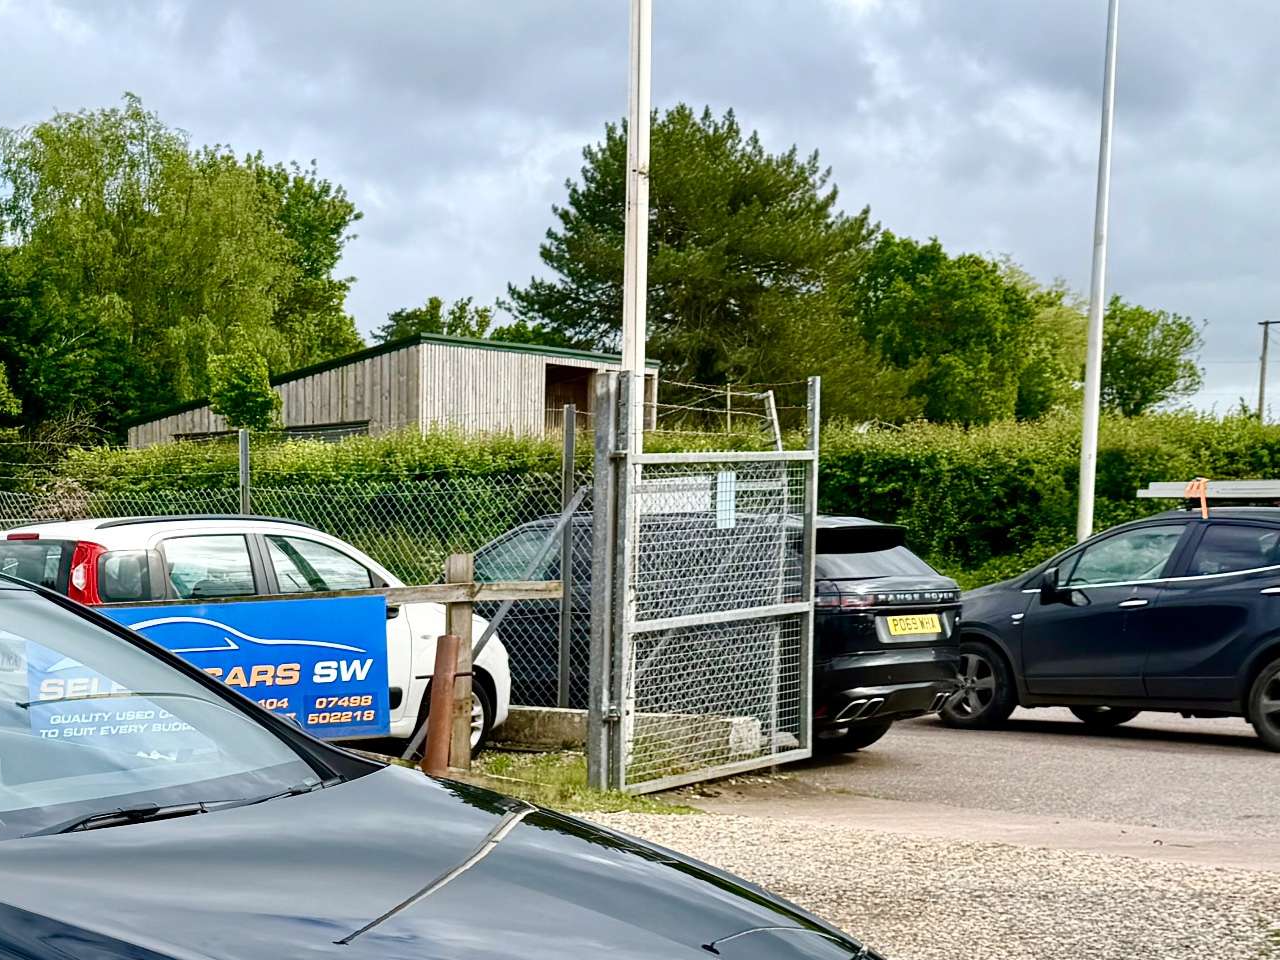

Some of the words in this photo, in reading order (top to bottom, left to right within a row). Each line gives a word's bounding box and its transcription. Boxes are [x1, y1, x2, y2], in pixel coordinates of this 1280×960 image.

[878, 593, 920, 601] RANGE
[924, 592, 954, 600] ROVER
[312, 659, 373, 683] SW
[315, 695, 373, 709] 07498
[50, 711, 113, 725] QUALITY
[115, 710, 155, 721] USED
[307, 710, 375, 725] 502218
[40, 729, 59, 739] TO
[63, 726, 97, 738] SUIT
[99, 723, 148, 736] EVERY
